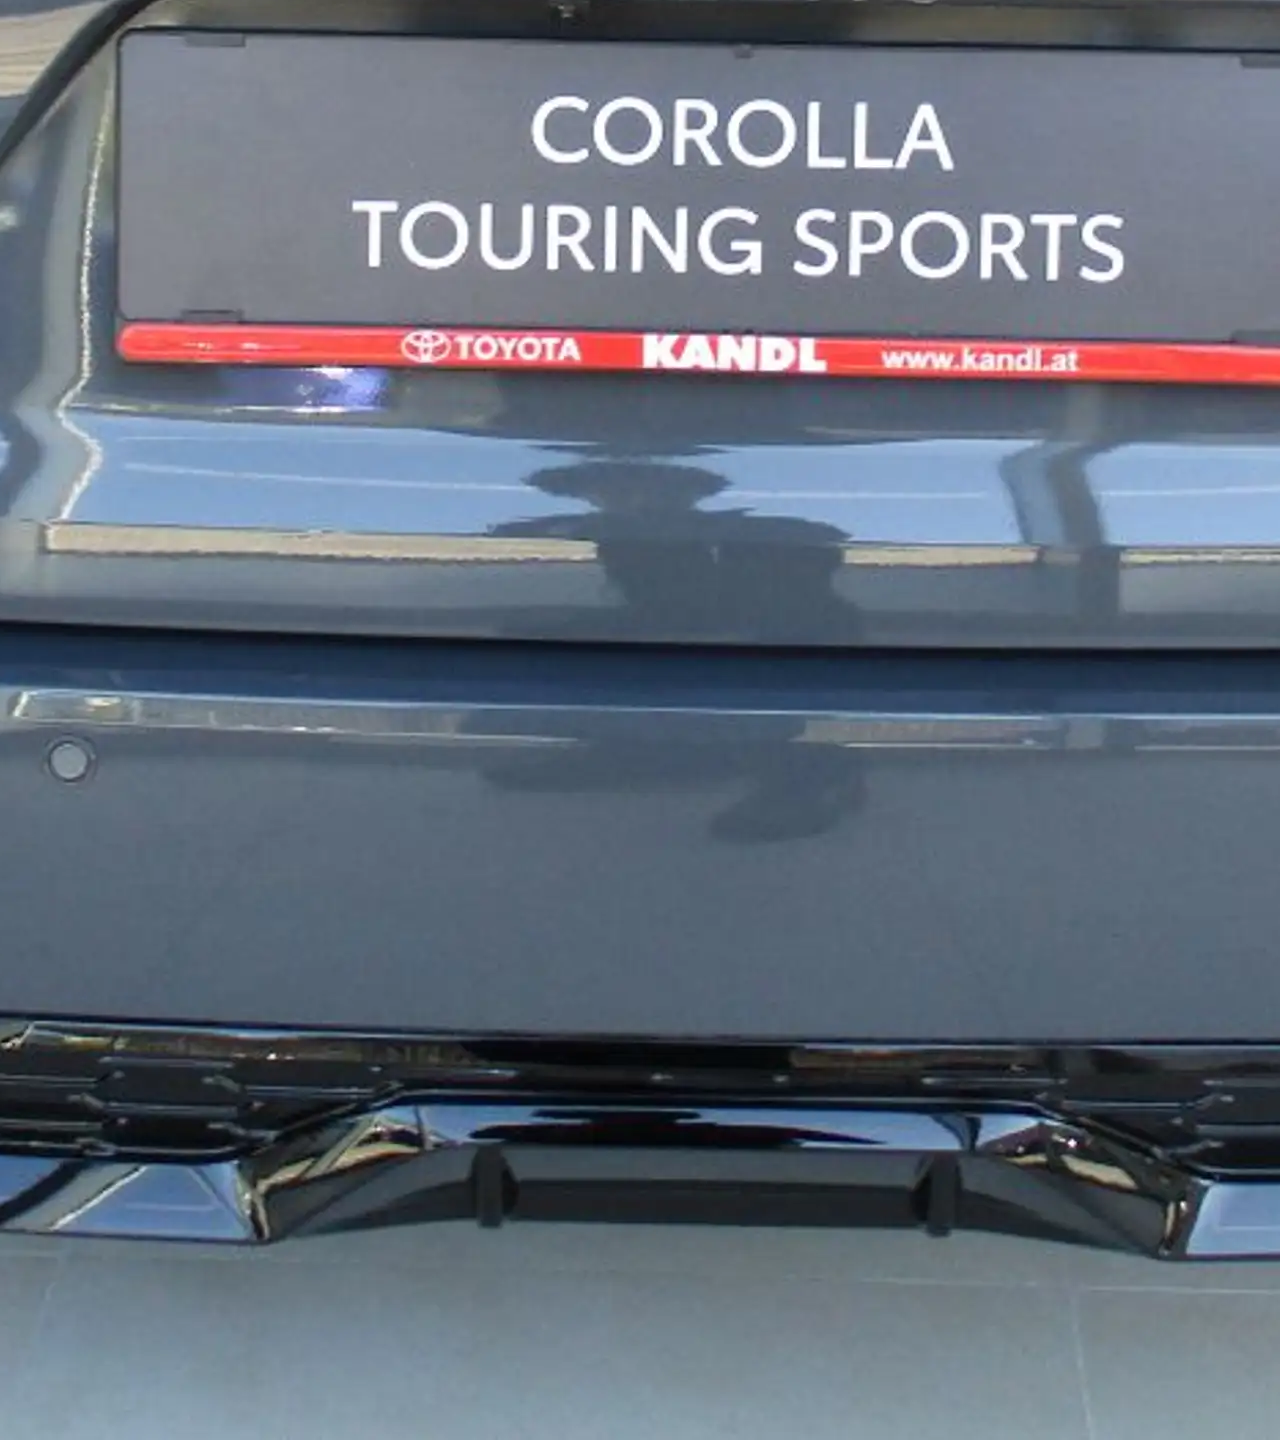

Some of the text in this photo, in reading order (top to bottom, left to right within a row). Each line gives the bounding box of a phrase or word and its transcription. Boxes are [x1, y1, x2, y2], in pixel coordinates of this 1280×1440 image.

[530, 95, 955, 171] COROLLA
[352, 200, 1125, 283] TOURING SPORTS
[455, 333, 1081, 373] TOYOTA KANDL www.kandl.at
